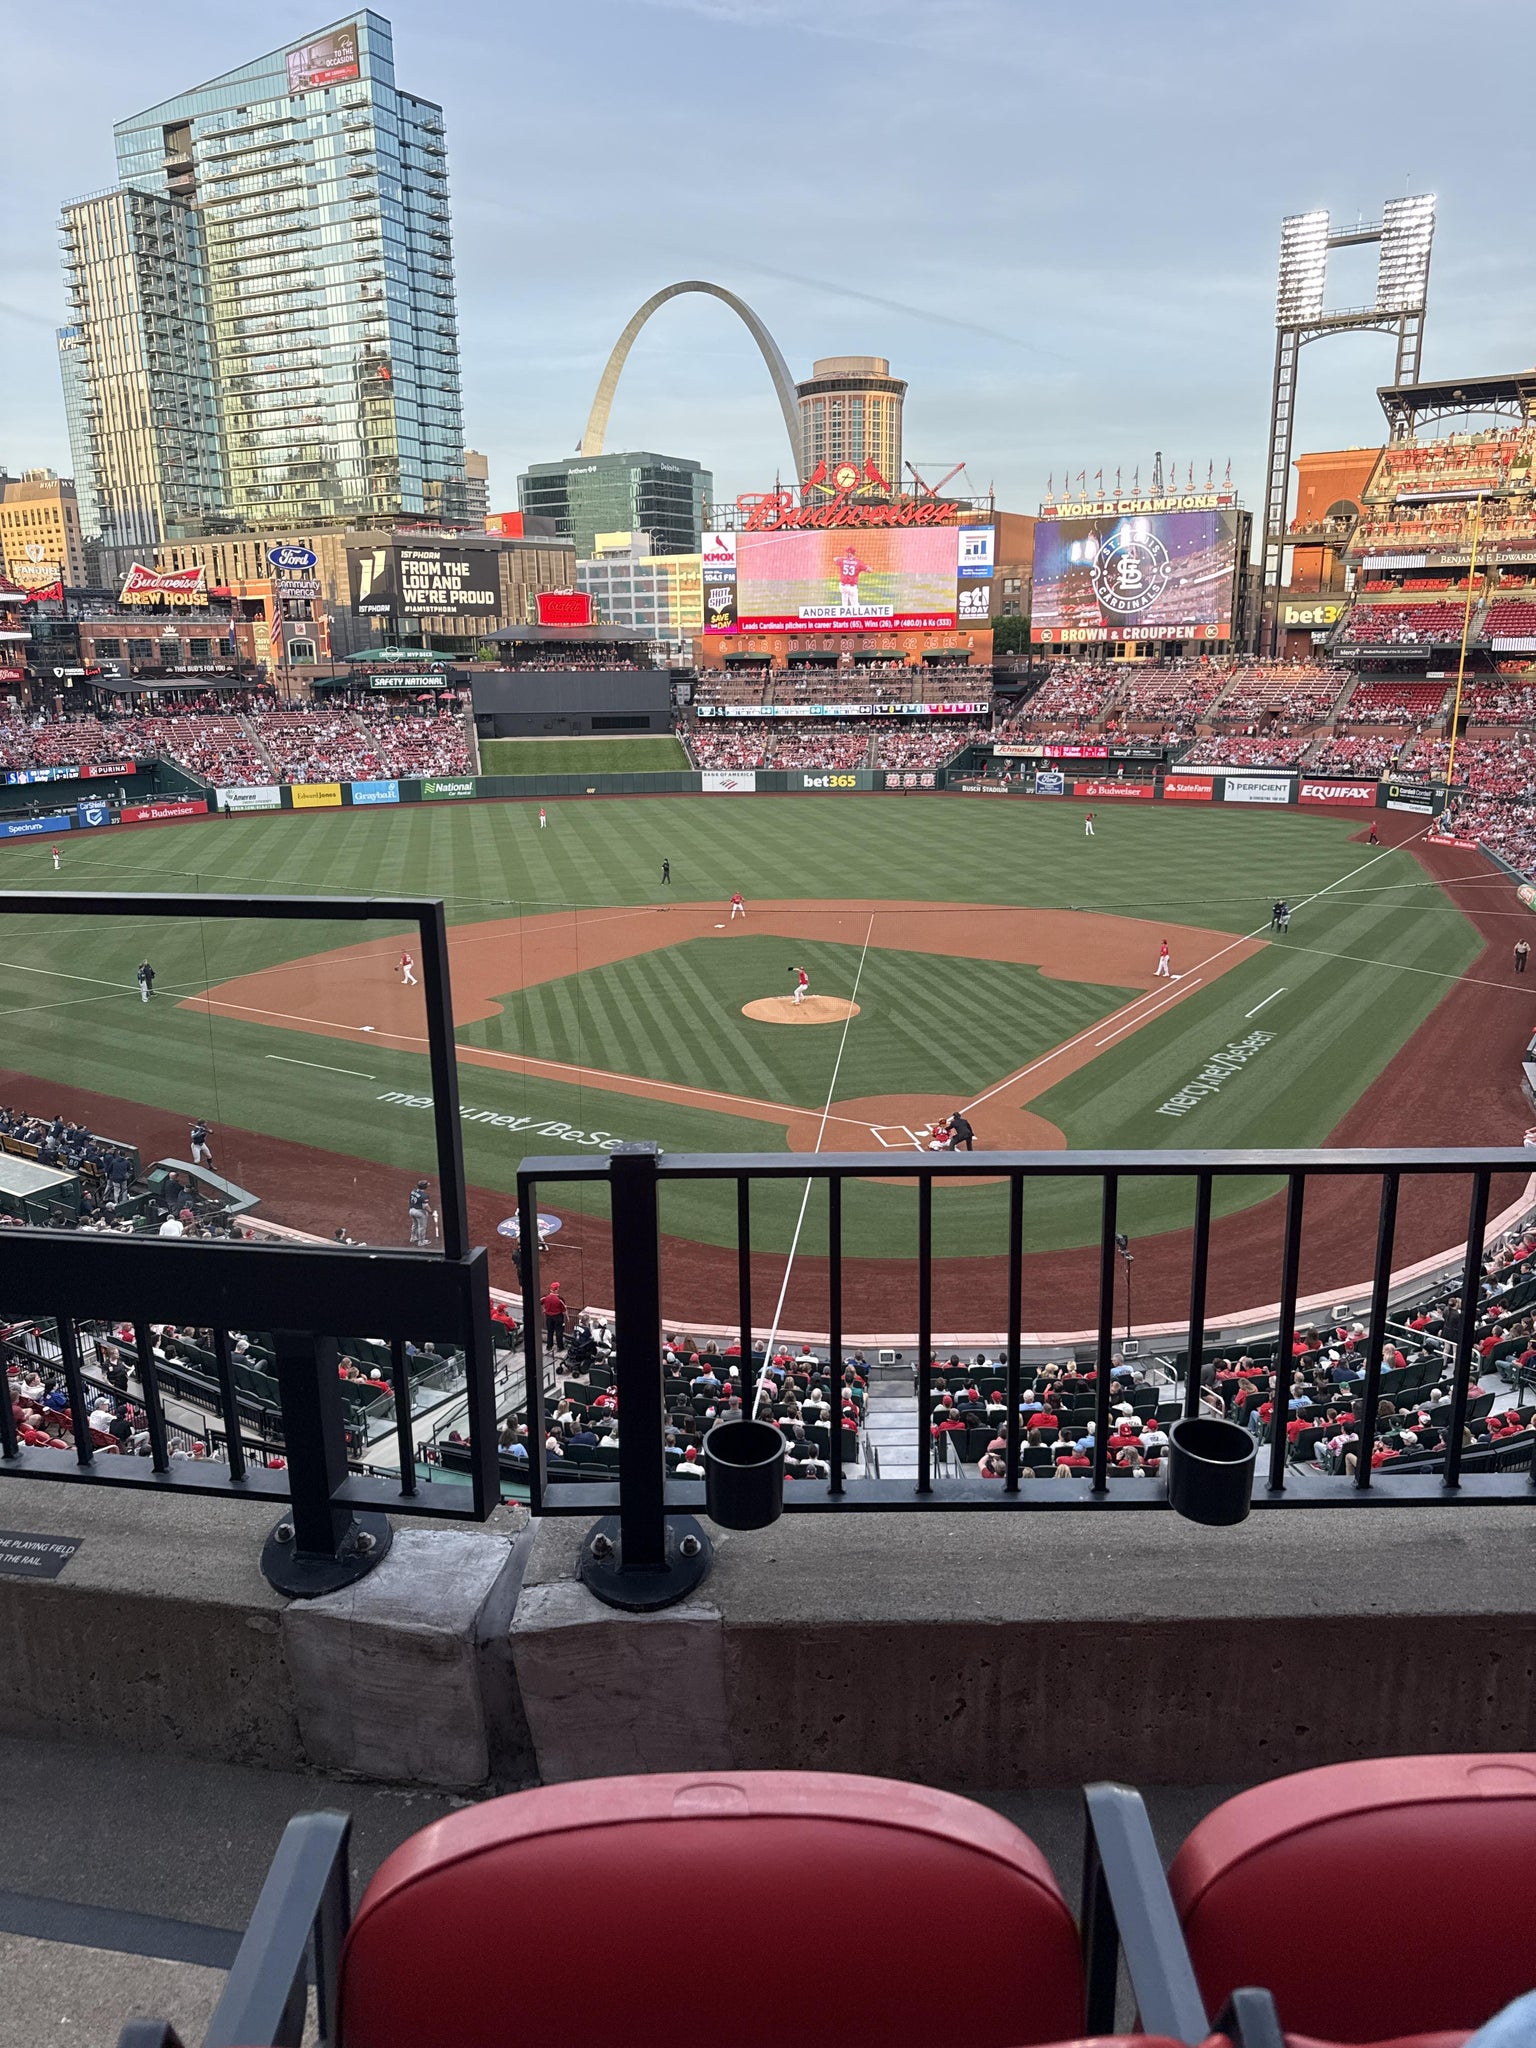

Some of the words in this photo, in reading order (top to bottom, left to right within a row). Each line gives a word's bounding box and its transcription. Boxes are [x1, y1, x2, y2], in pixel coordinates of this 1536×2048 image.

[334, 50, 342, 58] TO
[342, 47, 353, 55] THE
[325, 55, 354, 67] OCCASION
[568, 467, 588, 475] Anthem
[1056, 503, 1114, 517] WORLD
[1117, 495, 1218, 515] CHAMPIONS
[737, 493, 959, 531] Budweiser
[279, 549, 309, 565] Ford
[704, 553, 735, 562] KMOX
[401, 561, 441, 576] FROM
[443, 562, 470, 576] THE
[842, 565, 856, 576] 53
[119, 572, 206, 590] Budweiser
[402, 575, 430, 589] LOU
[432, 576, 462, 590] AND
[724, 573, 736, 581] FM
[275, 578, 320, 590] Community
[402, 589, 448, 603] WE'RE
[450, 590, 495, 605] PROUD
[711, 588, 729, 598] HOT
[959, 586, 990, 607] stl
[1099, 584, 1160, 610] CARDINALS
[122, 592, 161, 605] BREW
[164, 592, 209, 606] HOUSE
[709, 596, 732, 607] SHOT
[803, 607, 836, 617] ANDRE
[840, 606, 890, 617] PALLANTE
[959, 606, 989, 614] TODAY
[717, 620, 732, 630] DAY
[742, 622, 758, 630] Leads
[785, 622, 807, 630] pitchers
[1061, 628, 1108, 642] BROWN
[1111, 629, 1119, 640] &
[1123, 627, 1195, 640] CROUPPEN
[738, 640, 742, 652] 1
[748, 640, 756, 652] 2
[760, 640, 768, 652] 6
[774, 640, 781, 652] 9
[788, 640, 798, 652] 10
[805, 640, 816, 651] 14
[822, 639, 834, 650] 17
[840, 639, 854, 650] 20
[862, 638, 876, 650] 23
[882, 638, 896, 650] 24
[902, 638, 917, 649] 42
[924, 637, 938, 648] 45
[943, 636, 957, 648] 85
[405, 678, 443, 686] NATIONAL
[98, 765, 126, 774] PURINA
[10, 773, 16, 783] S
[804, 775, 856, 788] bet365
[1042, 774, 1058, 783] Ford
[436, 782, 473, 792] National
[1098, 787, 1141, 796] Budweiser
[1301, 784, 1370, 800] EQUIFAX
[79, 801, 106, 810] CarShield
[150, 806, 193, 818] Budweiser
[8, 823, 41, 834] Spectrum
[1155, 1030, 1278, 1117] mercy.net/BeSeen
[10, 1540, 50, 1551] PLAYING
[4, 1554, 21, 1563] THE
[20, 1556, 42, 1566] RAIL.
